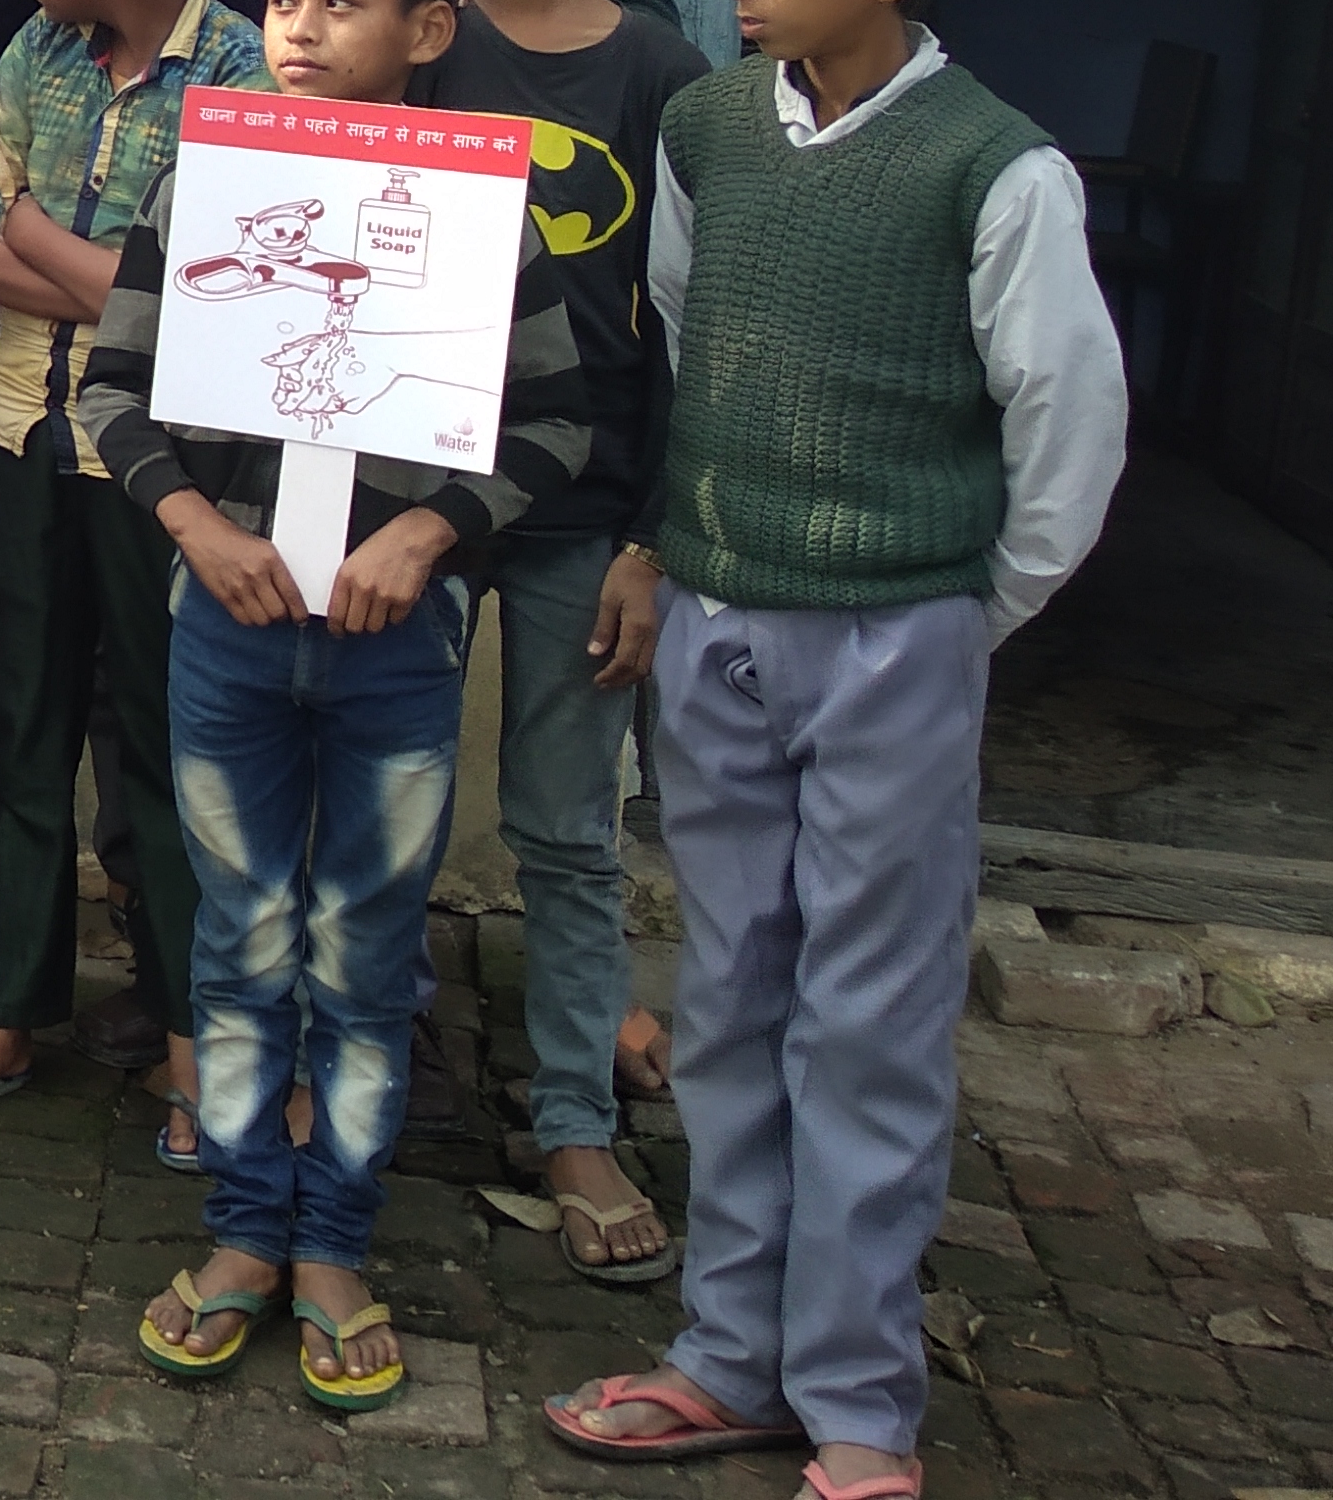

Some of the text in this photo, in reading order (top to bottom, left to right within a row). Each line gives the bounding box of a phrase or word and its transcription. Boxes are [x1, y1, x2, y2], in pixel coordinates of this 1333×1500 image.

[199, 107, 517, 154] खाना खाने से पहले साबुन से हाथ साफ करें
[367, 221, 422, 238] Liquid
[370, 238, 416, 255] Soap
[434, 432, 477, 452] Water
